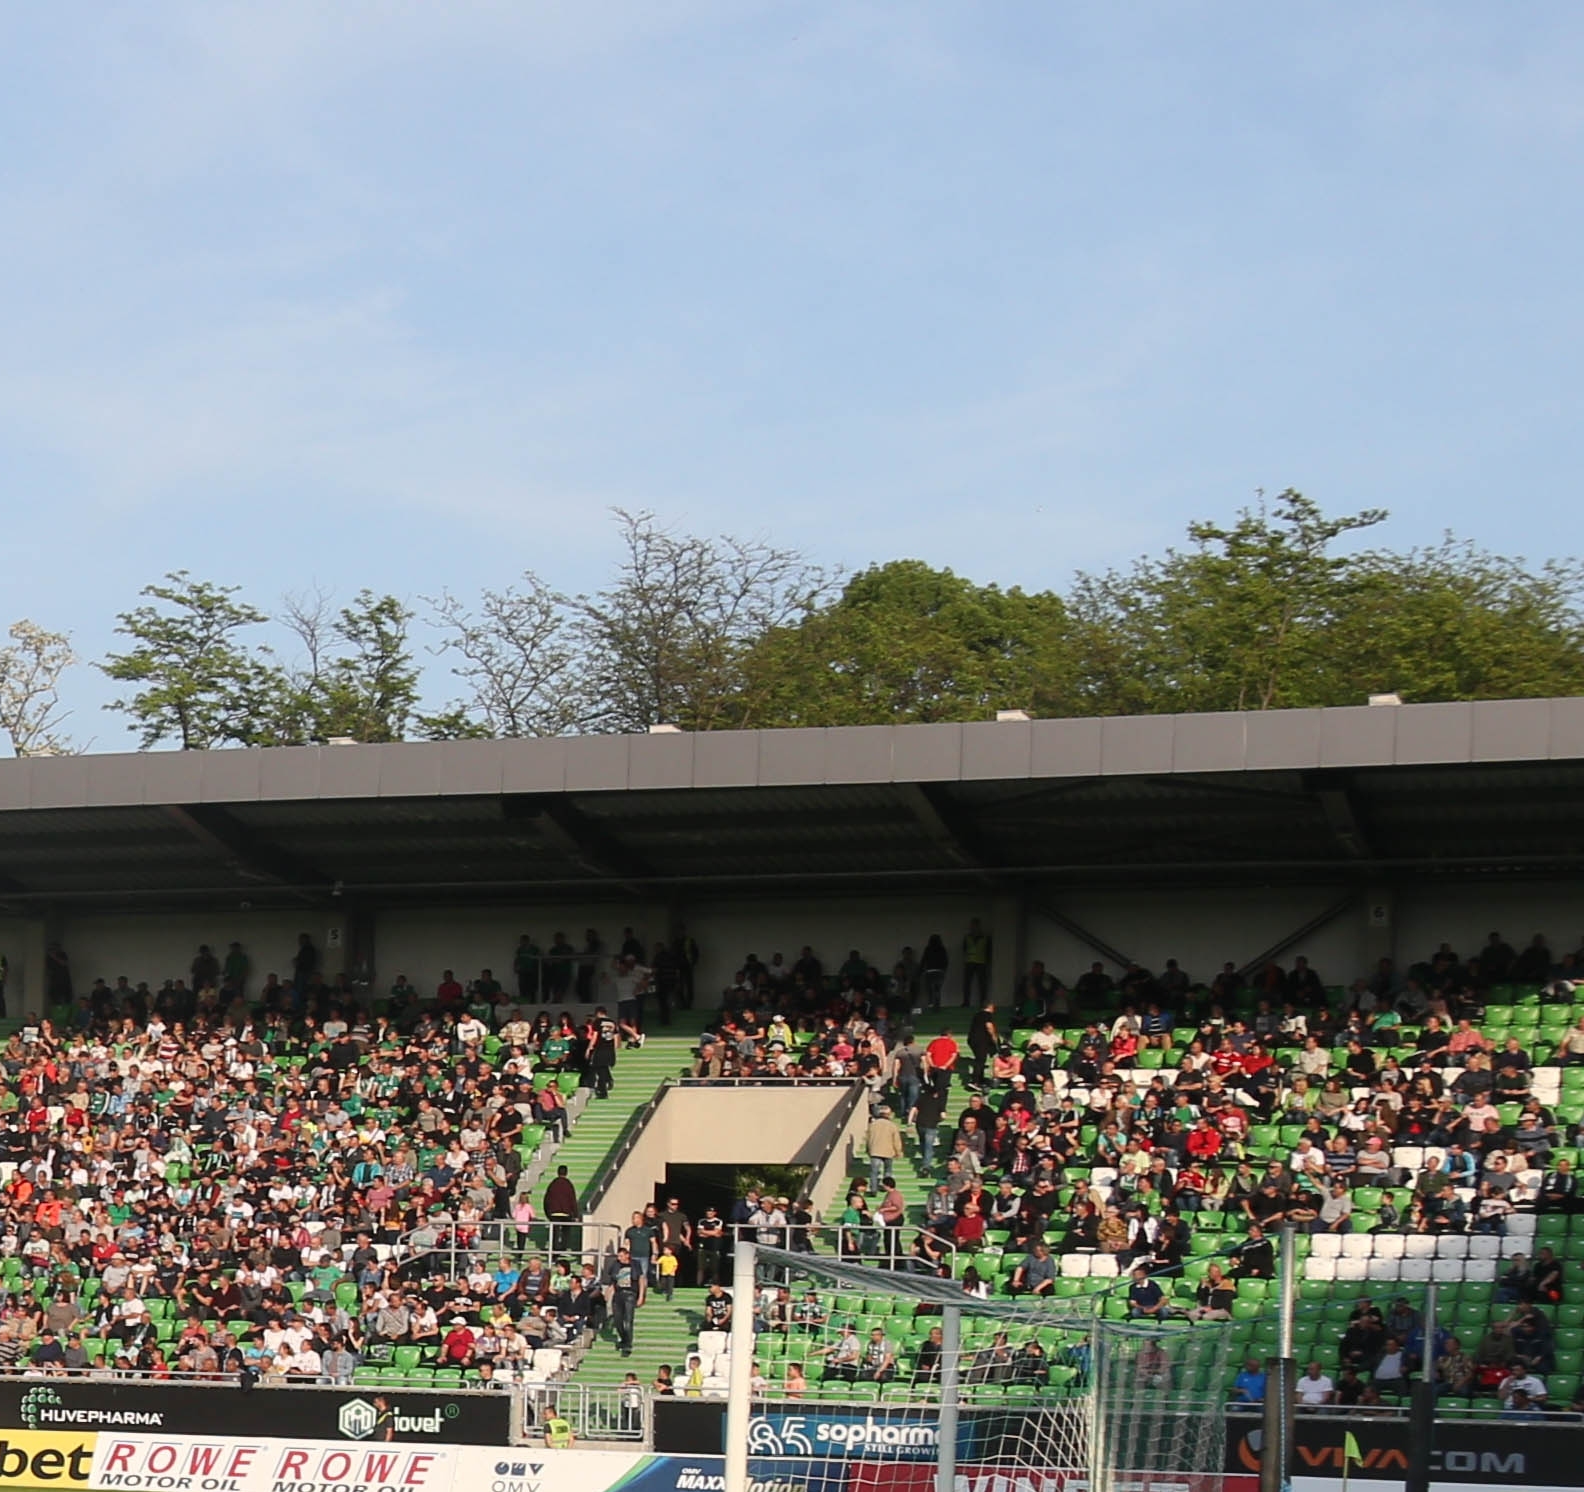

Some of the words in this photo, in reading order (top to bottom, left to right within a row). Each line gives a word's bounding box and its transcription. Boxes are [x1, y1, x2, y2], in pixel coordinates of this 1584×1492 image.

[40, 1408, 163, 1426] HUVEPHARMA
[392, 1406, 445, 1434] iovet
[816, 1417, 942, 1450] sopharm
[864, 1444, 894, 1454] STILL
[896, 1446, 940, 1456] GROWI
[104, 1442, 257, 1478] ROWE
[278, 1449, 435, 1486] ROWE
[99, 1473, 193, 1491] MOTOR
[201, 1478, 241, 1492] OIL
